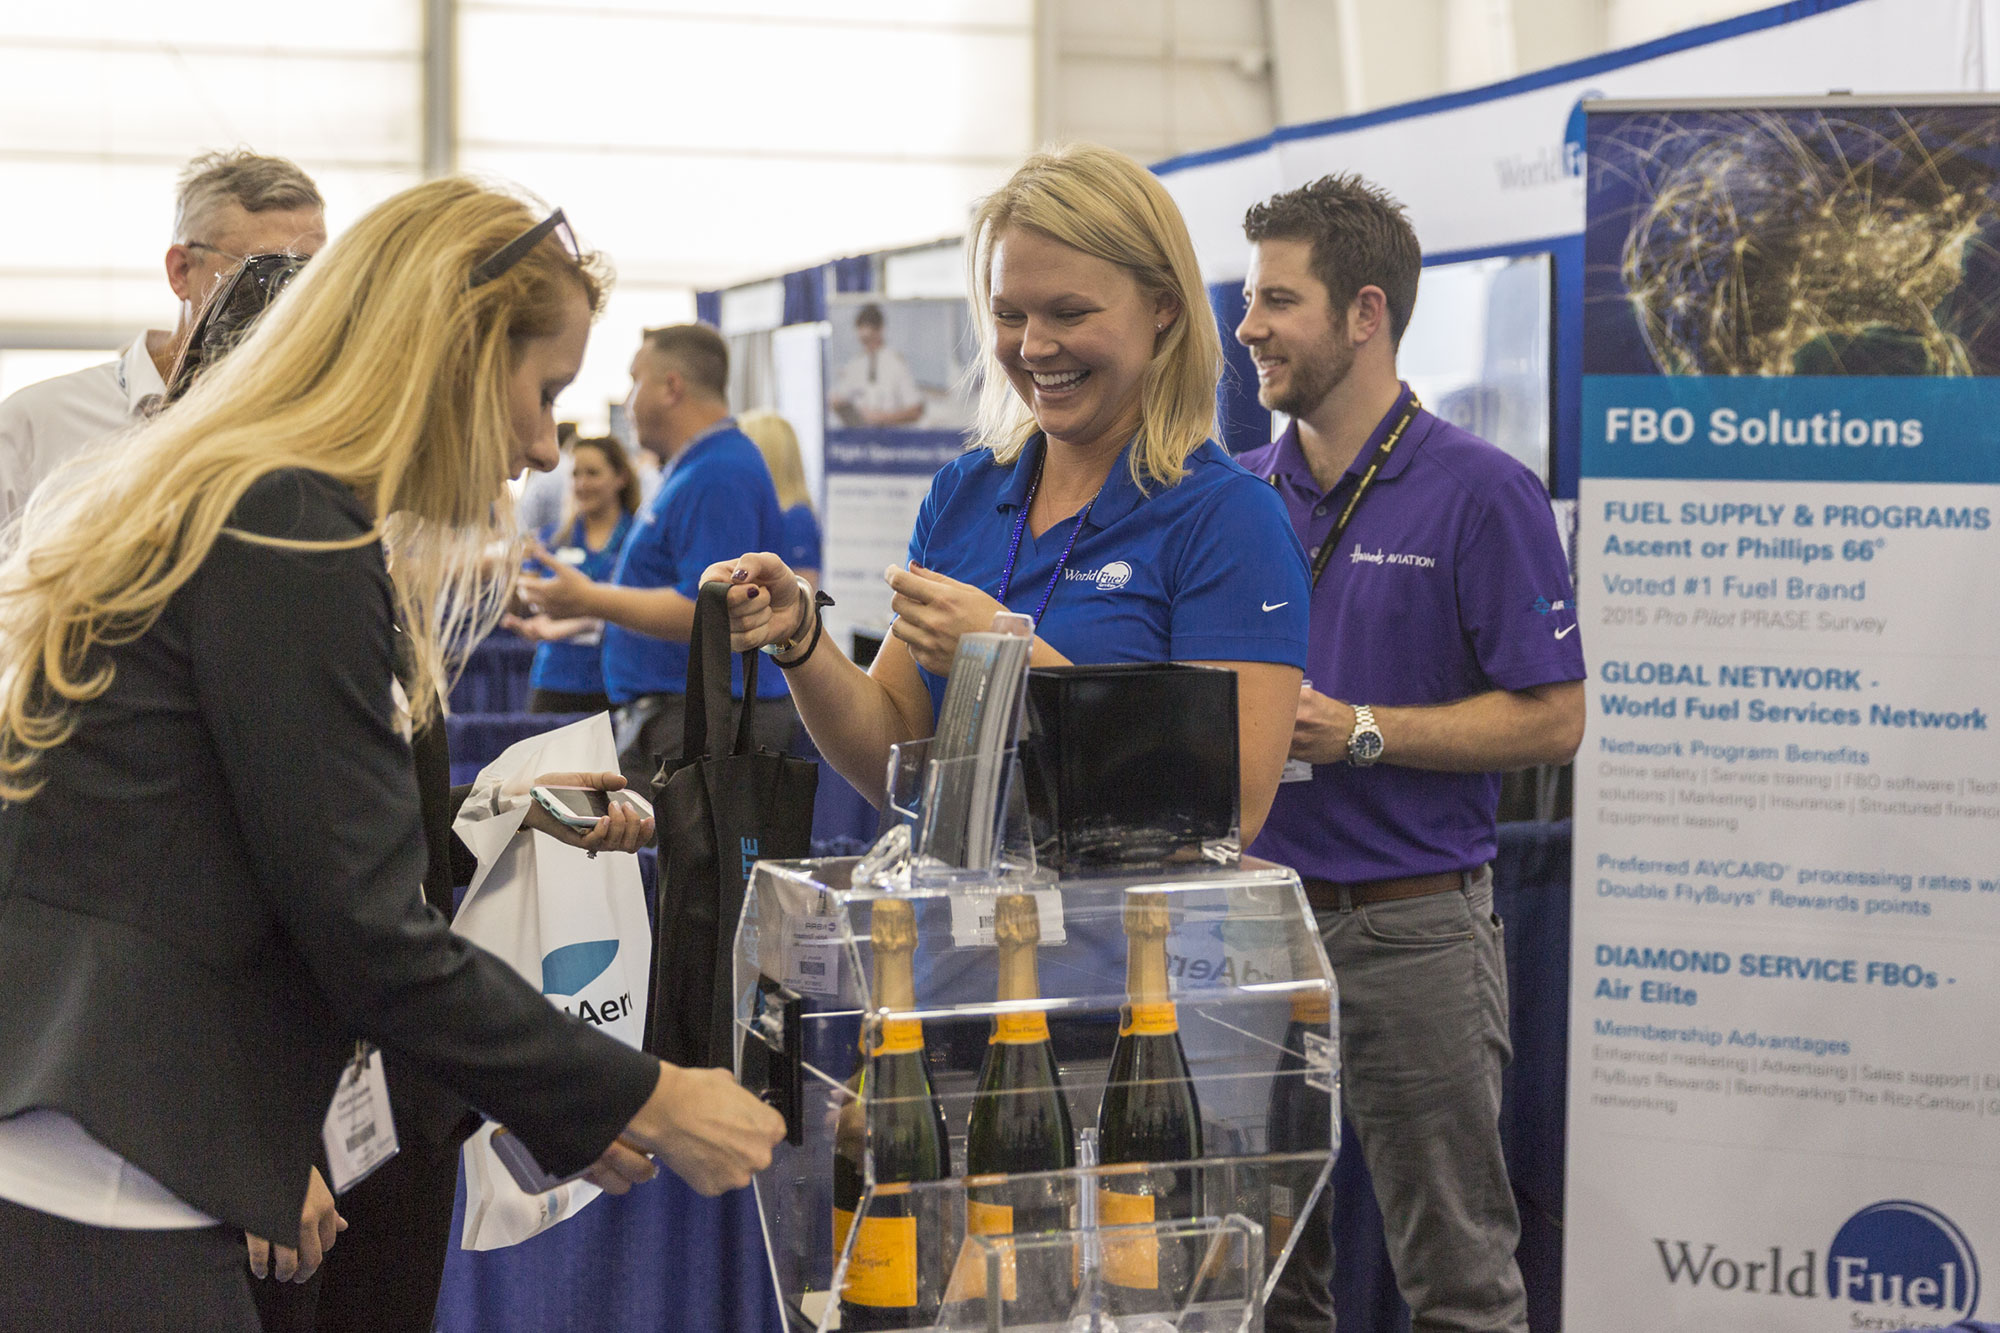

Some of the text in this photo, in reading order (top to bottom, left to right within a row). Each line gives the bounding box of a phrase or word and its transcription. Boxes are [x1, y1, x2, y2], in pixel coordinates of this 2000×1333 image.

[1605, 407, 1924, 447] FBO Solutions
[1604, 501, 1992, 530] FUEL SUPPLY & PROGRAMS
[1386, 553, 1436, 568] AVIATION
[1603, 534, 1692, 558] Ascent
[1701, 541, 1729, 558] or
[1736, 536, 1834, 565] Phillips
[1064, 568, 1127, 584] World Fuel
[1602, 573, 1866, 600] Voted #1 Fuel Brand
[1602, 606, 1887, 635] 2015 Pro Pilot PRASE Survey
[1601, 661, 1711, 687] GLOBAL
[1719, 664, 1861, 691] NETWORK
[1600, 694, 1988, 730] World Fuel Services Network
[1600, 736, 1870, 765] Network Program Benefits
[1884, 776, 1955, 794] software
[1678, 789, 1757, 810] Marketing
[1859, 796, 1942, 816] Structured
[1597, 853, 1690, 875] Preferred
[1797, 868, 1913, 893] processing
[1917, 875, 1971, 893] rates
[1597, 878, 1669, 900] Double
[1769, 888, 1859, 912] Rewards
[1864, 897, 1931, 918] points
[1596, 944, 1731, 974] DIAMOND
[1739, 953, 1858, 983] SERVICE
[1866, 961, 1939, 989] FBOs
[1595, 977, 1698, 1006] Air Elite
[1594, 1018, 1851, 1057] Membership Advantages
[1652, 1237, 1964, 1313] World Fuel
